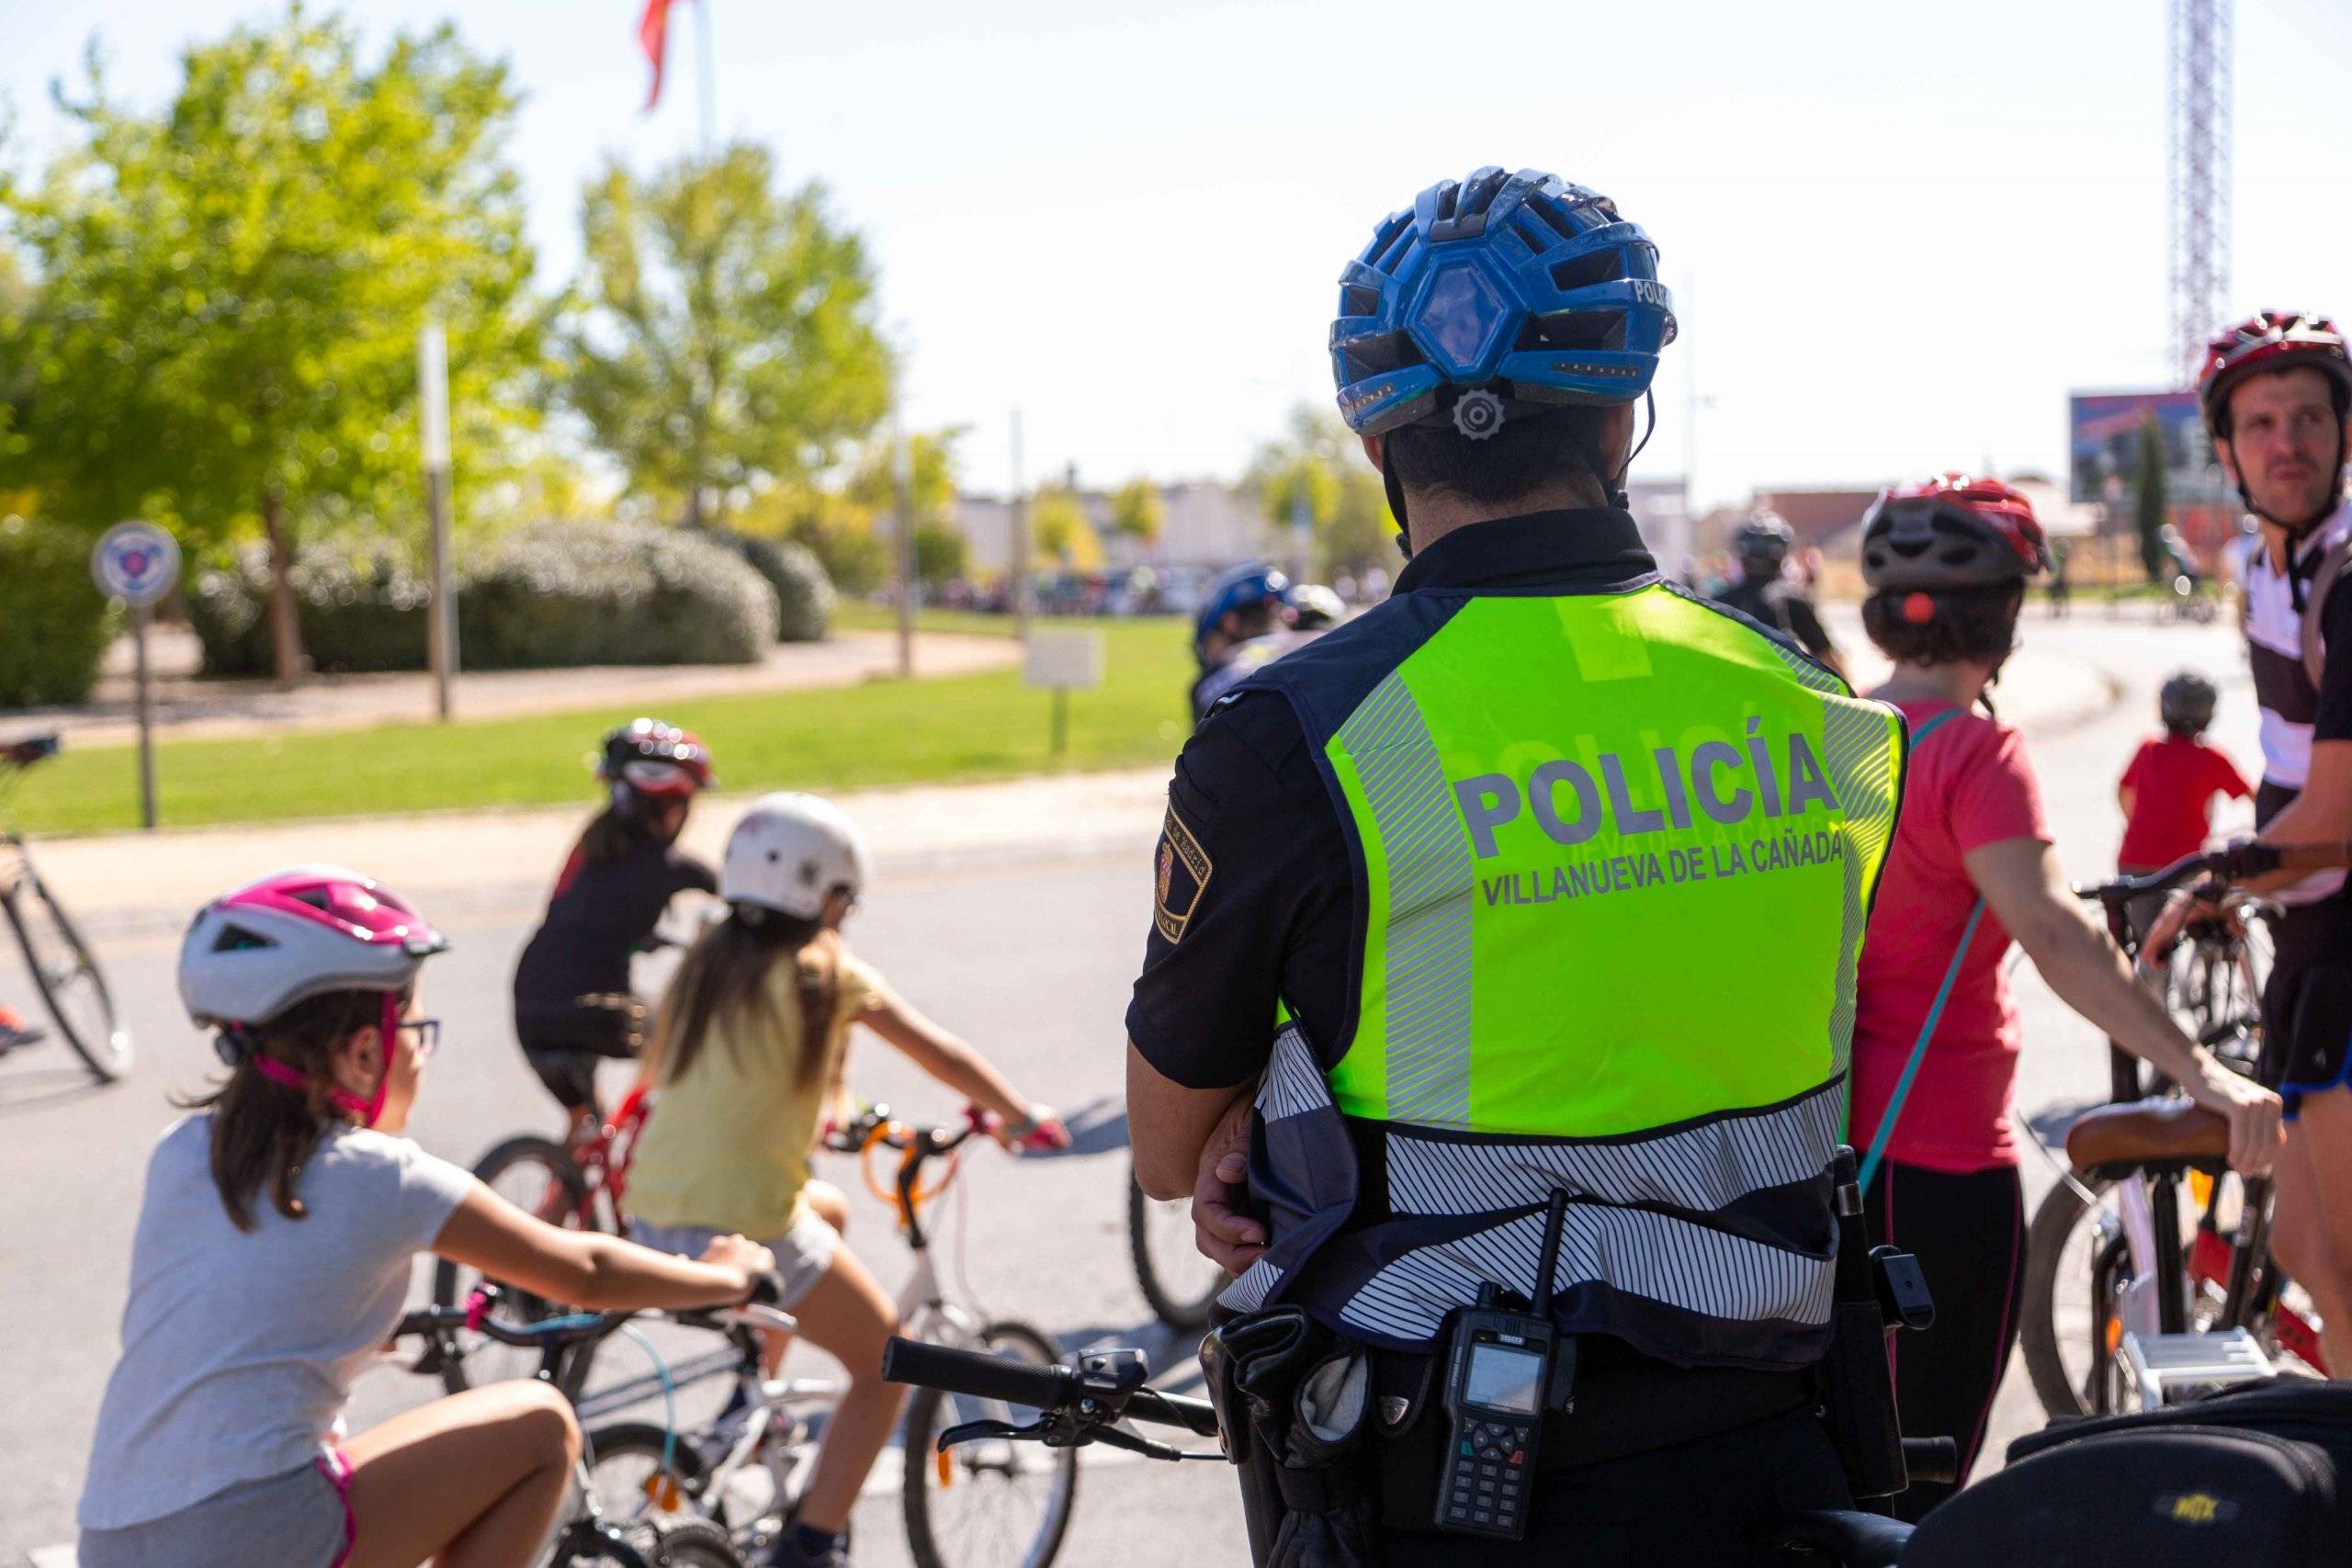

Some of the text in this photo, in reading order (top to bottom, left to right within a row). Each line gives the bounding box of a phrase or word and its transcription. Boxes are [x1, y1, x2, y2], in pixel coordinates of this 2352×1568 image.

[1453, 716, 1840, 859] POLICÍA
[1482, 828, 1843, 906] VILLANUEVA DE LA CAÑADA
